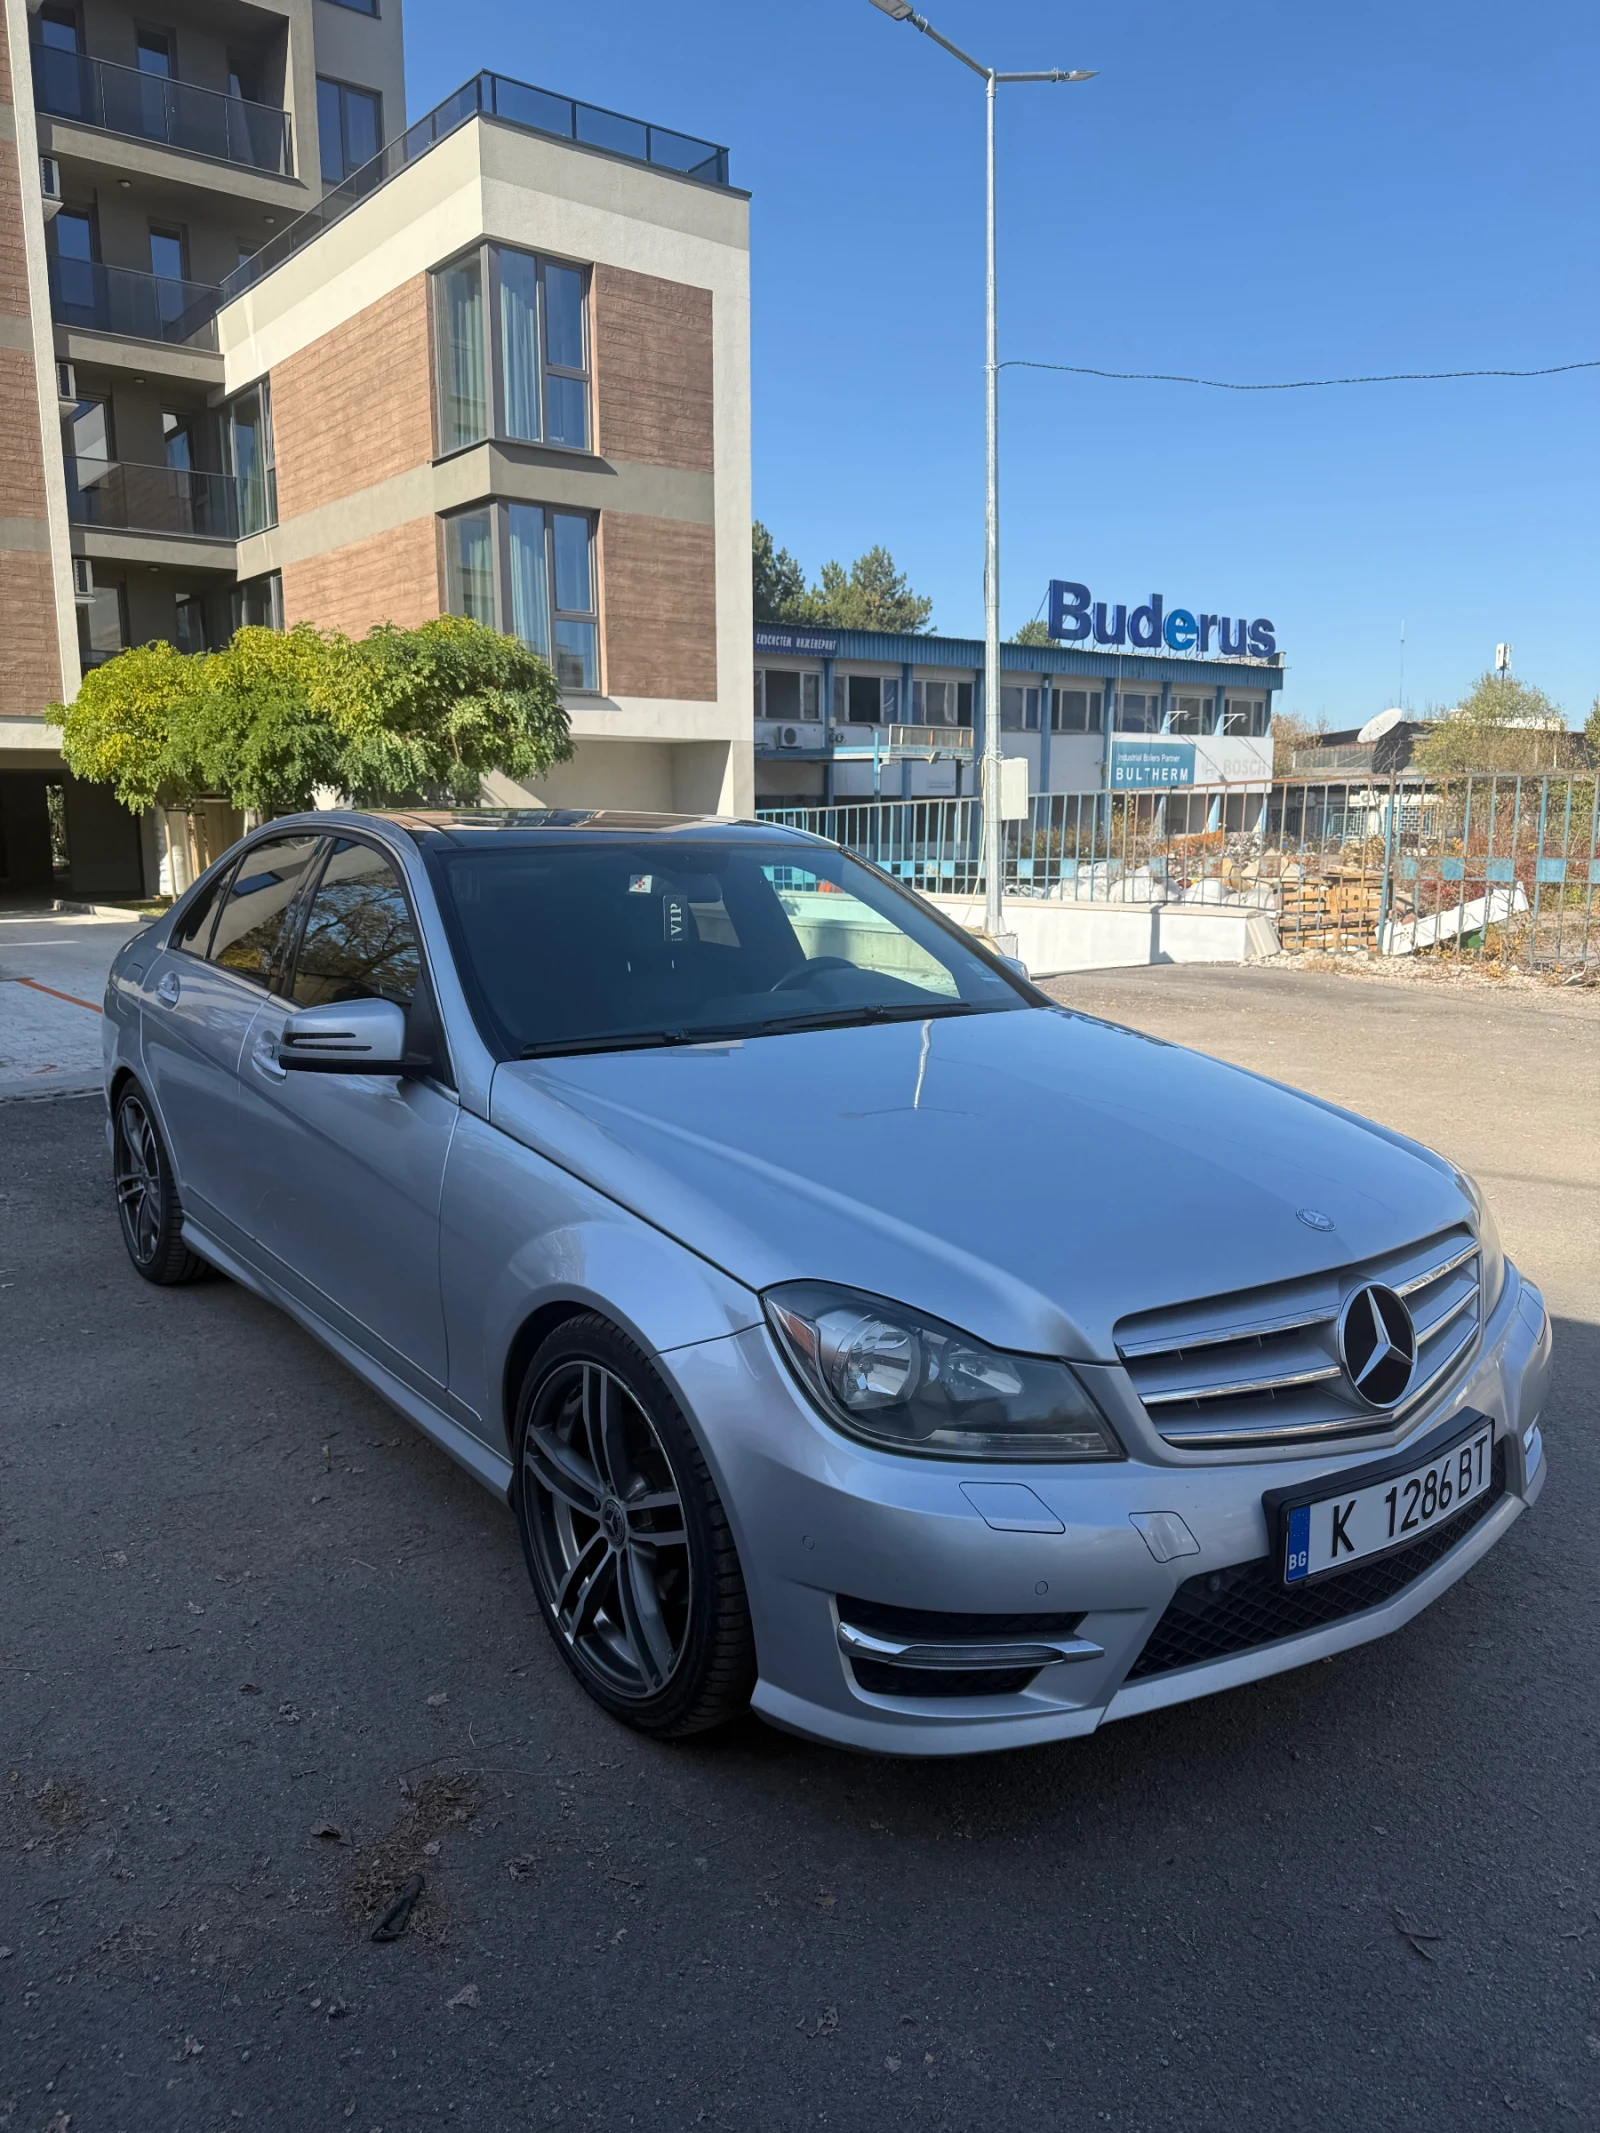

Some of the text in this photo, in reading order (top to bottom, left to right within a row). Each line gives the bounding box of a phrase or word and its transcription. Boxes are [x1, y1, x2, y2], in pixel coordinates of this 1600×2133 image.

[1048, 579, 1277, 658] Buderus
[1117, 752, 1142, 762] Industrial
[1161, 753, 1181, 763] Partner
[1223, 758, 1266, 776] BOSCH
[670, 903, 682, 936] VIP
[1330, 1500, 1357, 1558] K
[1384, 1459, 1453, 1538] 1286
[1287, 1551, 1308, 1571] BG
